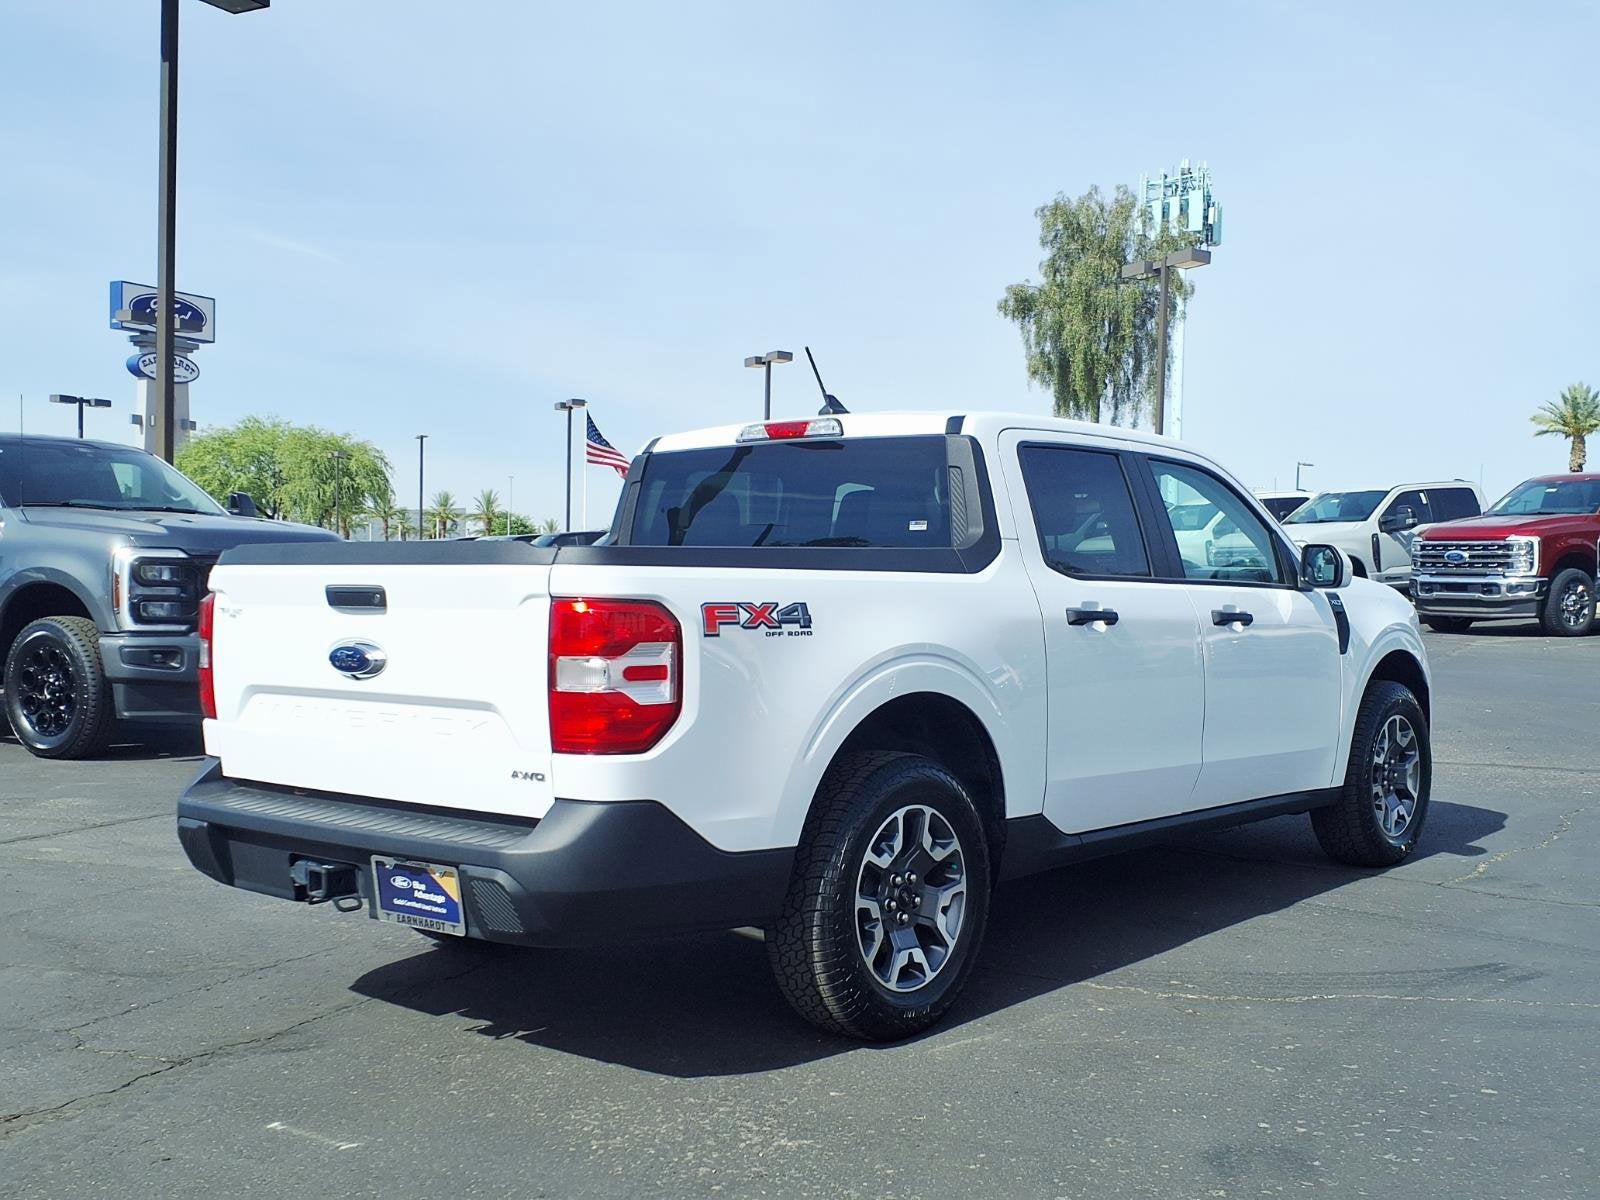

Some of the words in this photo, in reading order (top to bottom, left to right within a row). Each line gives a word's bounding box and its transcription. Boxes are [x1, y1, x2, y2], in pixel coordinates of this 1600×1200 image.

[700, 601, 812, 637] FX4
[765, 630, 785, 638] OFF
[396, 913, 446, 932] EARNHARDT
